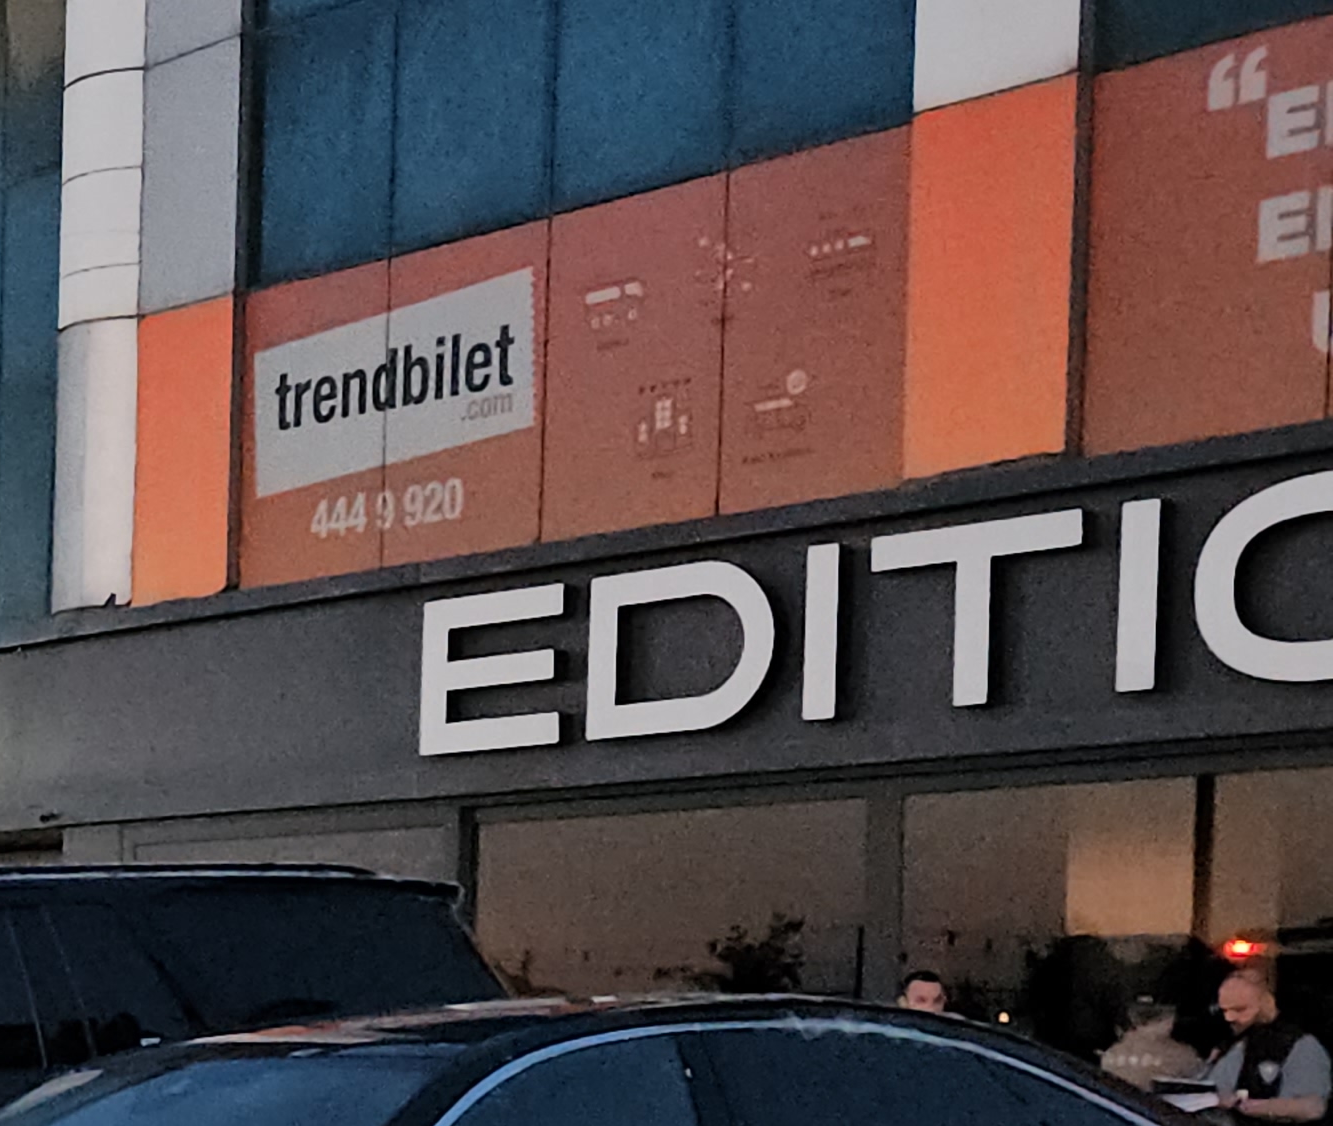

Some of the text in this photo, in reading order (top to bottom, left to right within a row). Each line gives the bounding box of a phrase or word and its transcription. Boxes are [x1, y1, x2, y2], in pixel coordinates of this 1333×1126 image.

[275, 324, 515, 430] trendbilet
[461, 392, 514, 422] .com
[310, 477, 464, 539] 444 9 920
